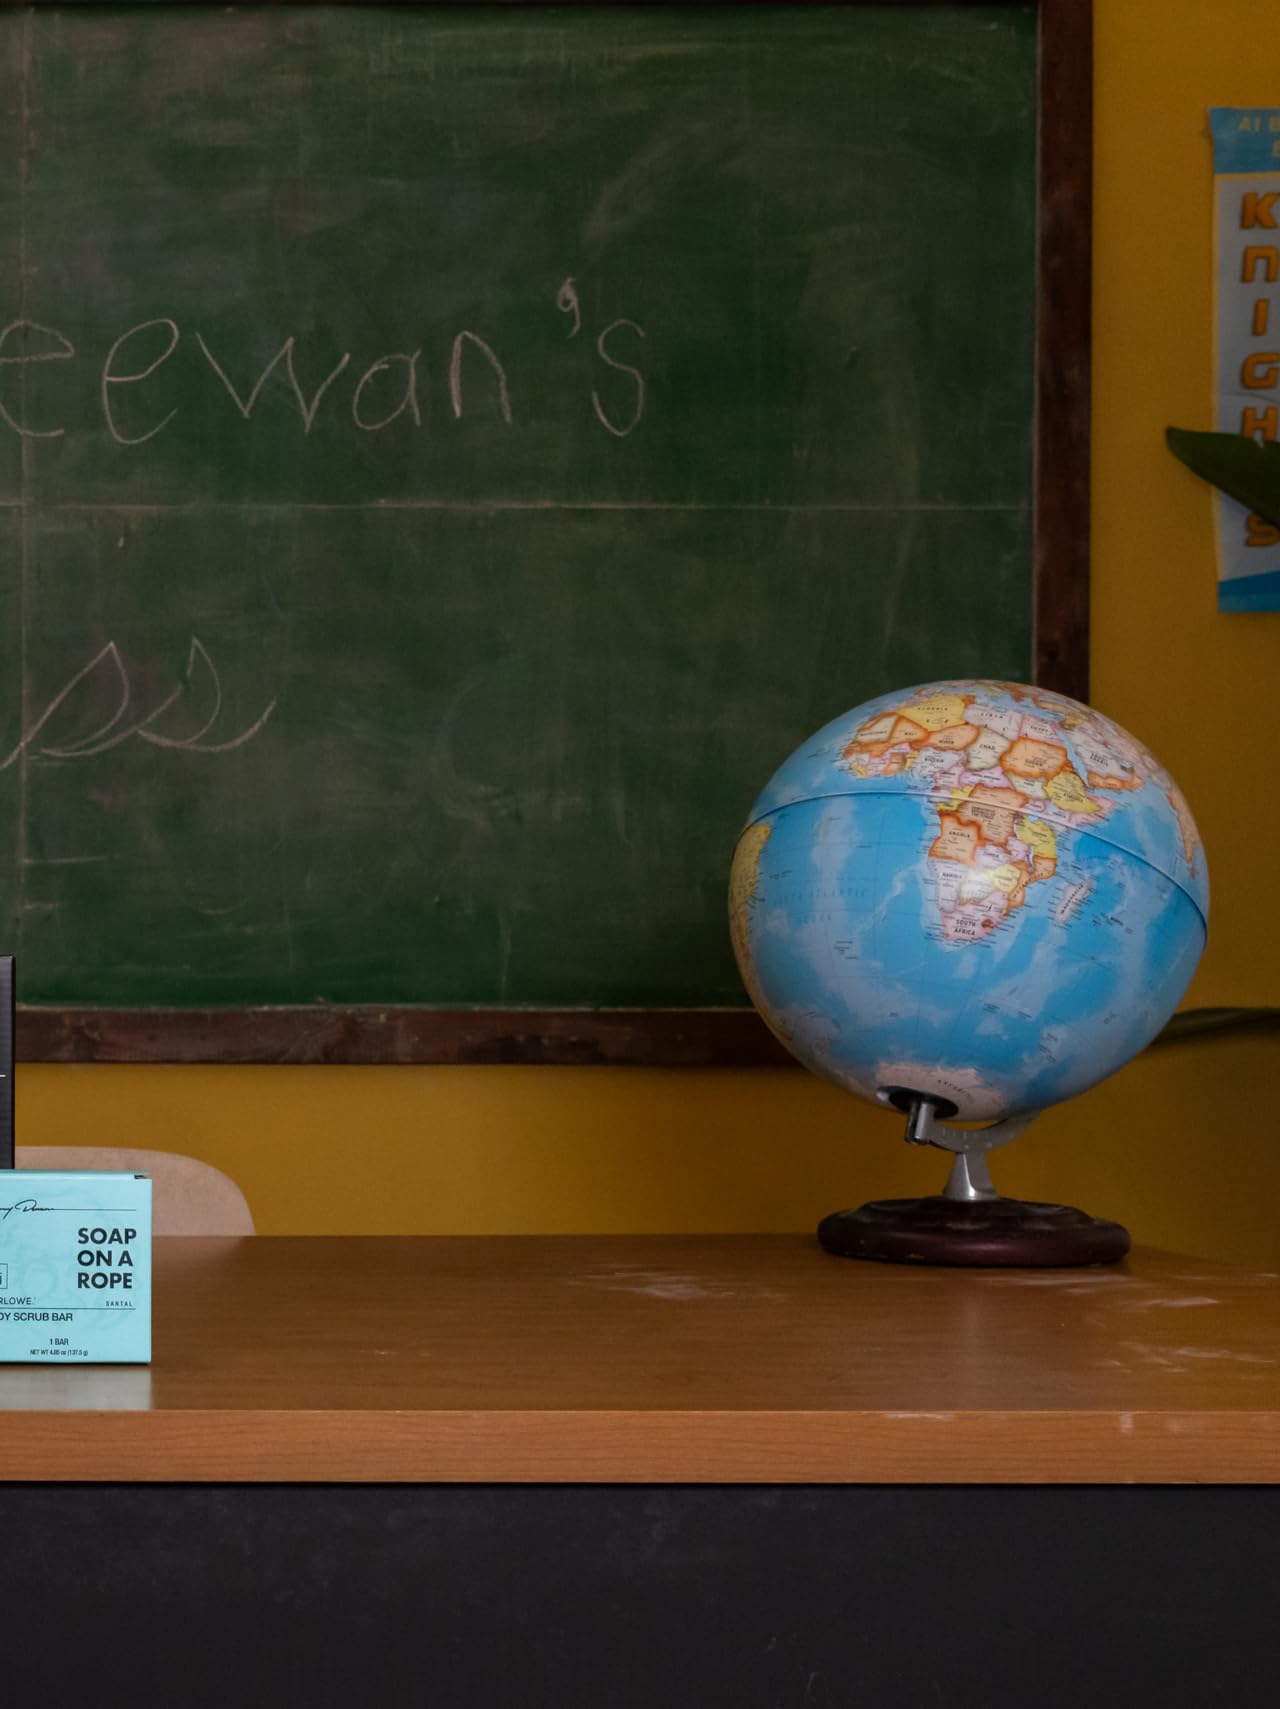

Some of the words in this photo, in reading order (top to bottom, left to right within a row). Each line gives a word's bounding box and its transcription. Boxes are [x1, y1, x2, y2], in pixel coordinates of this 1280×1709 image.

[955, 919, 976, 927] SOUTH
[954, 928, 976, 936] AFRICA
[77, 1228, 137, 1245] SOAP
[77, 1250, 113, 1267] ON
[117, 1250, 134, 1267] A
[77, 1272, 133, 1289] ROPE
[13, 1312, 50, 1321] SCRUB
[51, 1312, 73, 1321] BAR
